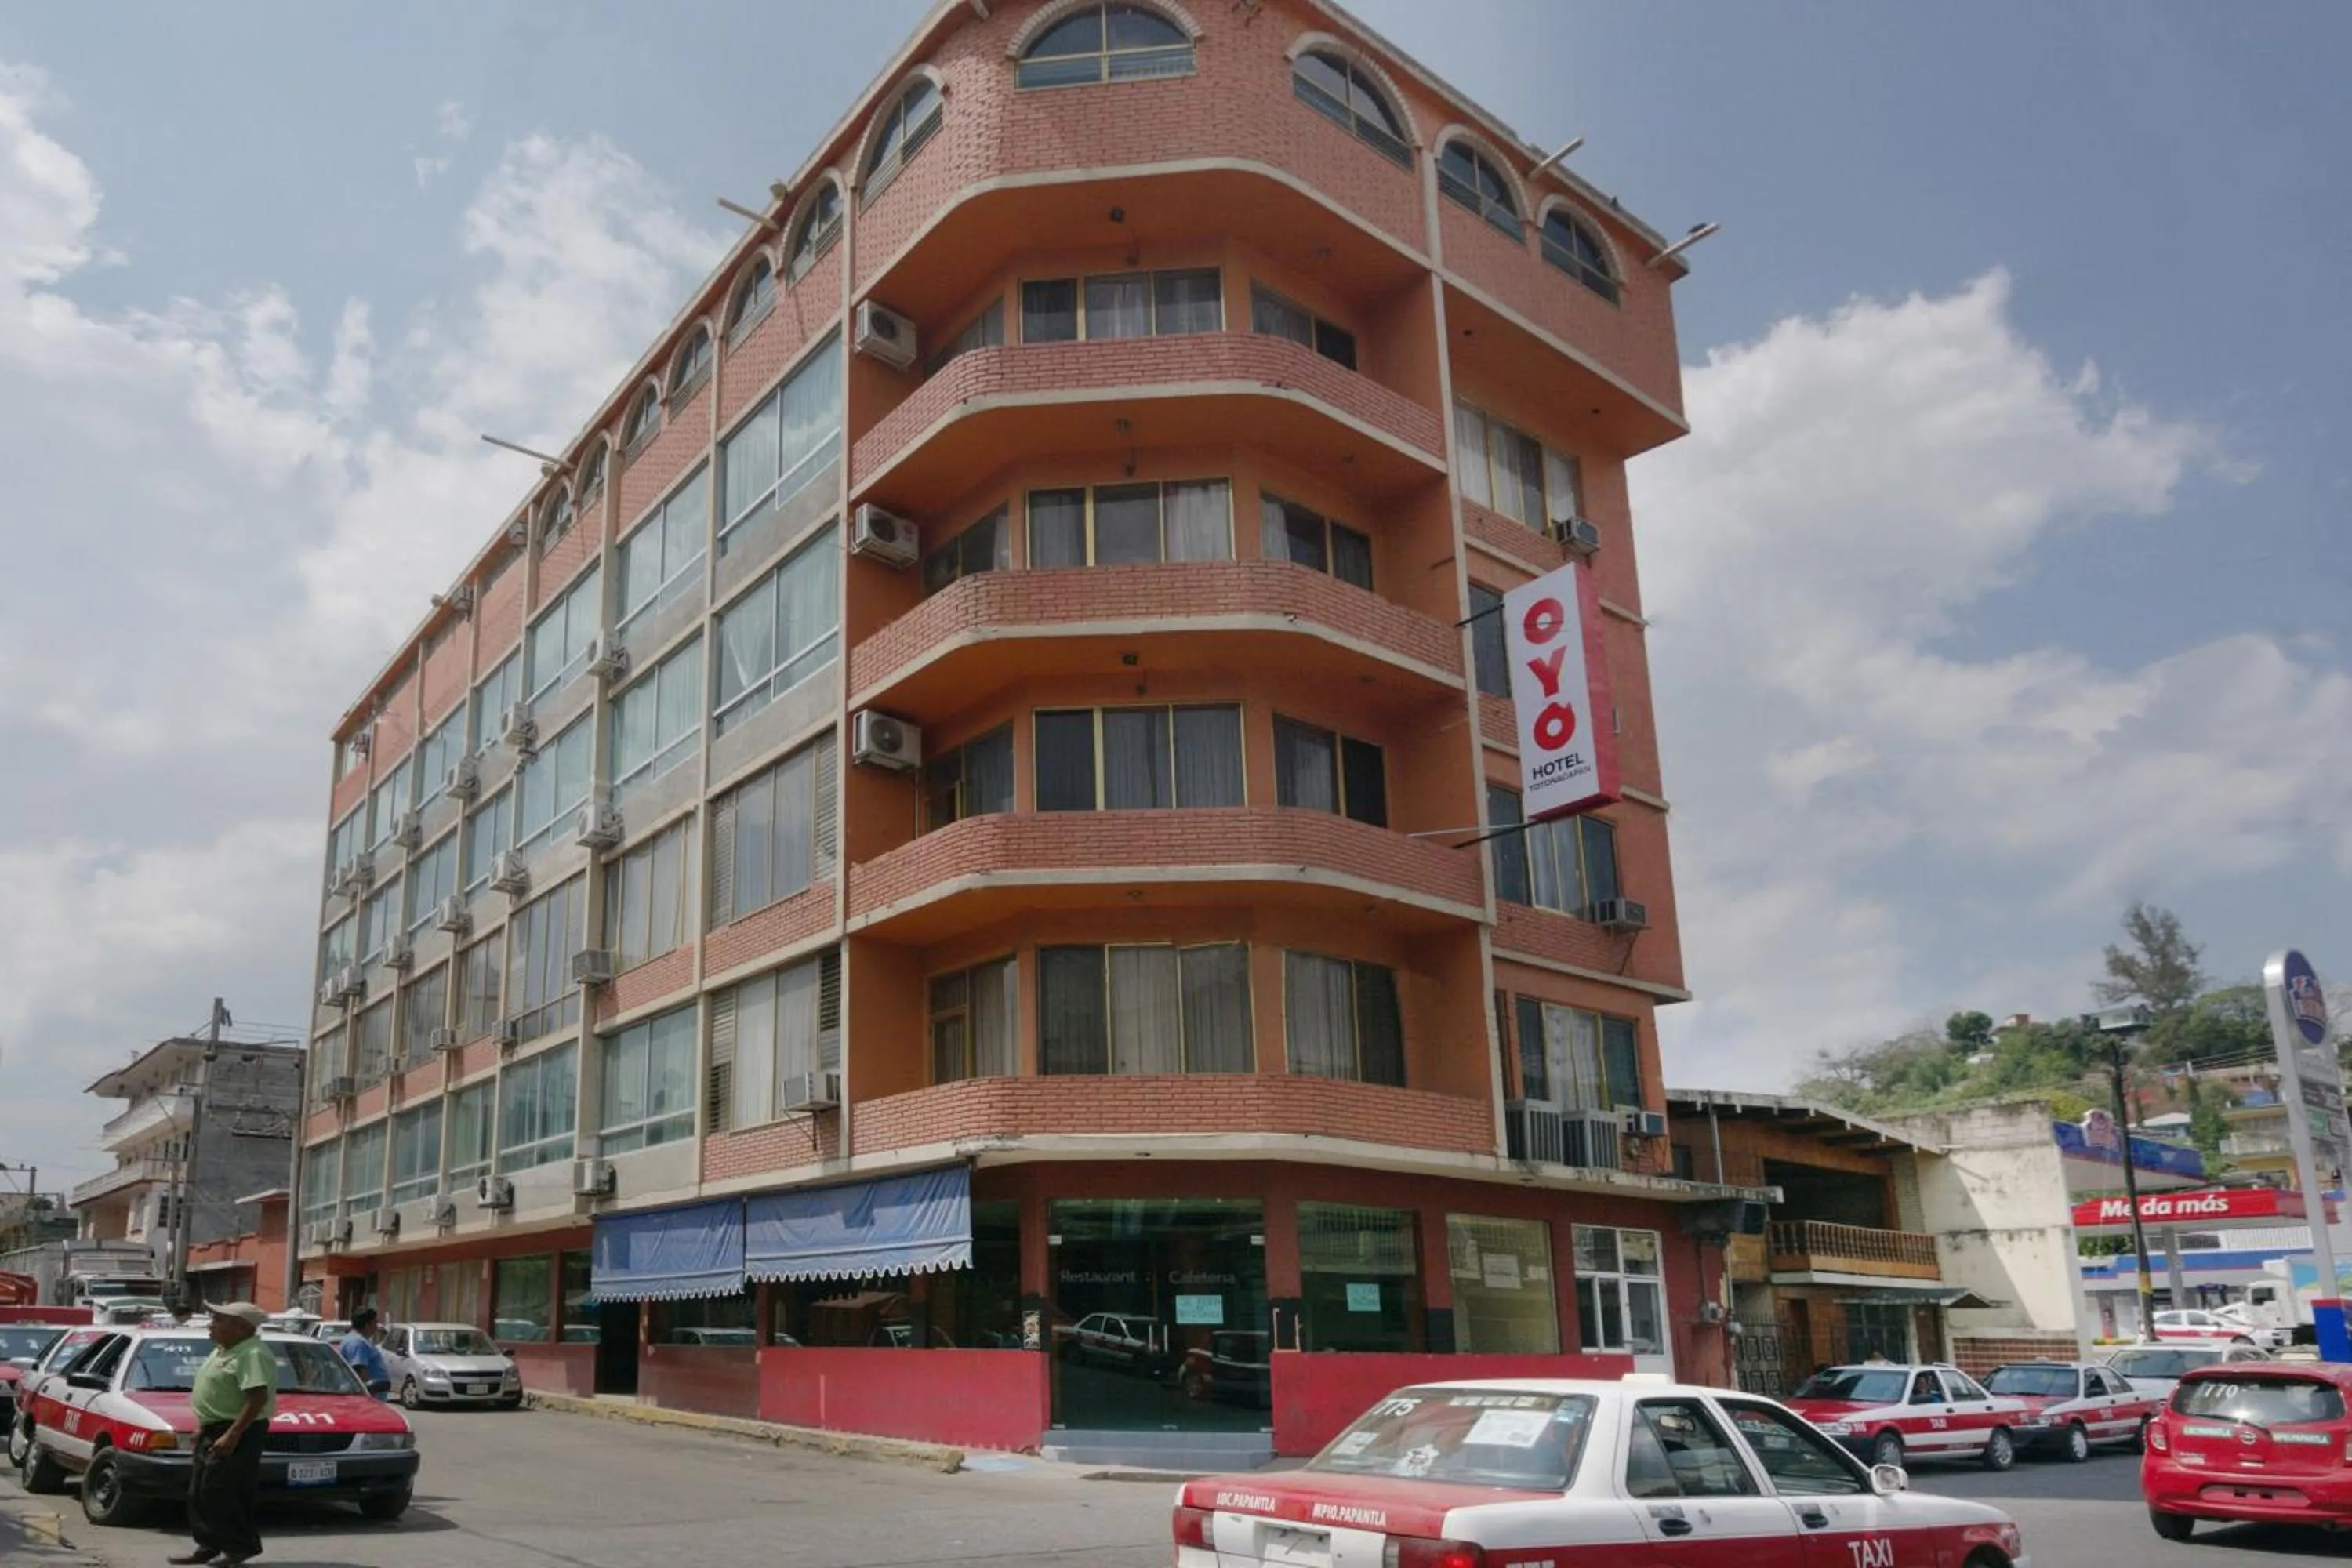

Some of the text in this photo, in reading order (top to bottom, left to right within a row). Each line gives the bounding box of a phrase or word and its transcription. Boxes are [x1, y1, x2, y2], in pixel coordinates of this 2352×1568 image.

[1523, 597, 1576, 751] OYO
[1529, 764, 1592, 792] TOTONACAPAN
[1532, 751, 1584, 781] HOTEL
[2100, 1193, 2230, 1218] Me da más
[1059, 1269, 1136, 1284] Restaurant
[64, 1409, 81, 1434] TAXI
[273, 1412, 336, 1425] 411
[129, 1432, 147, 1447] 411
[1847, 1538, 1894, 1568] TAXI
